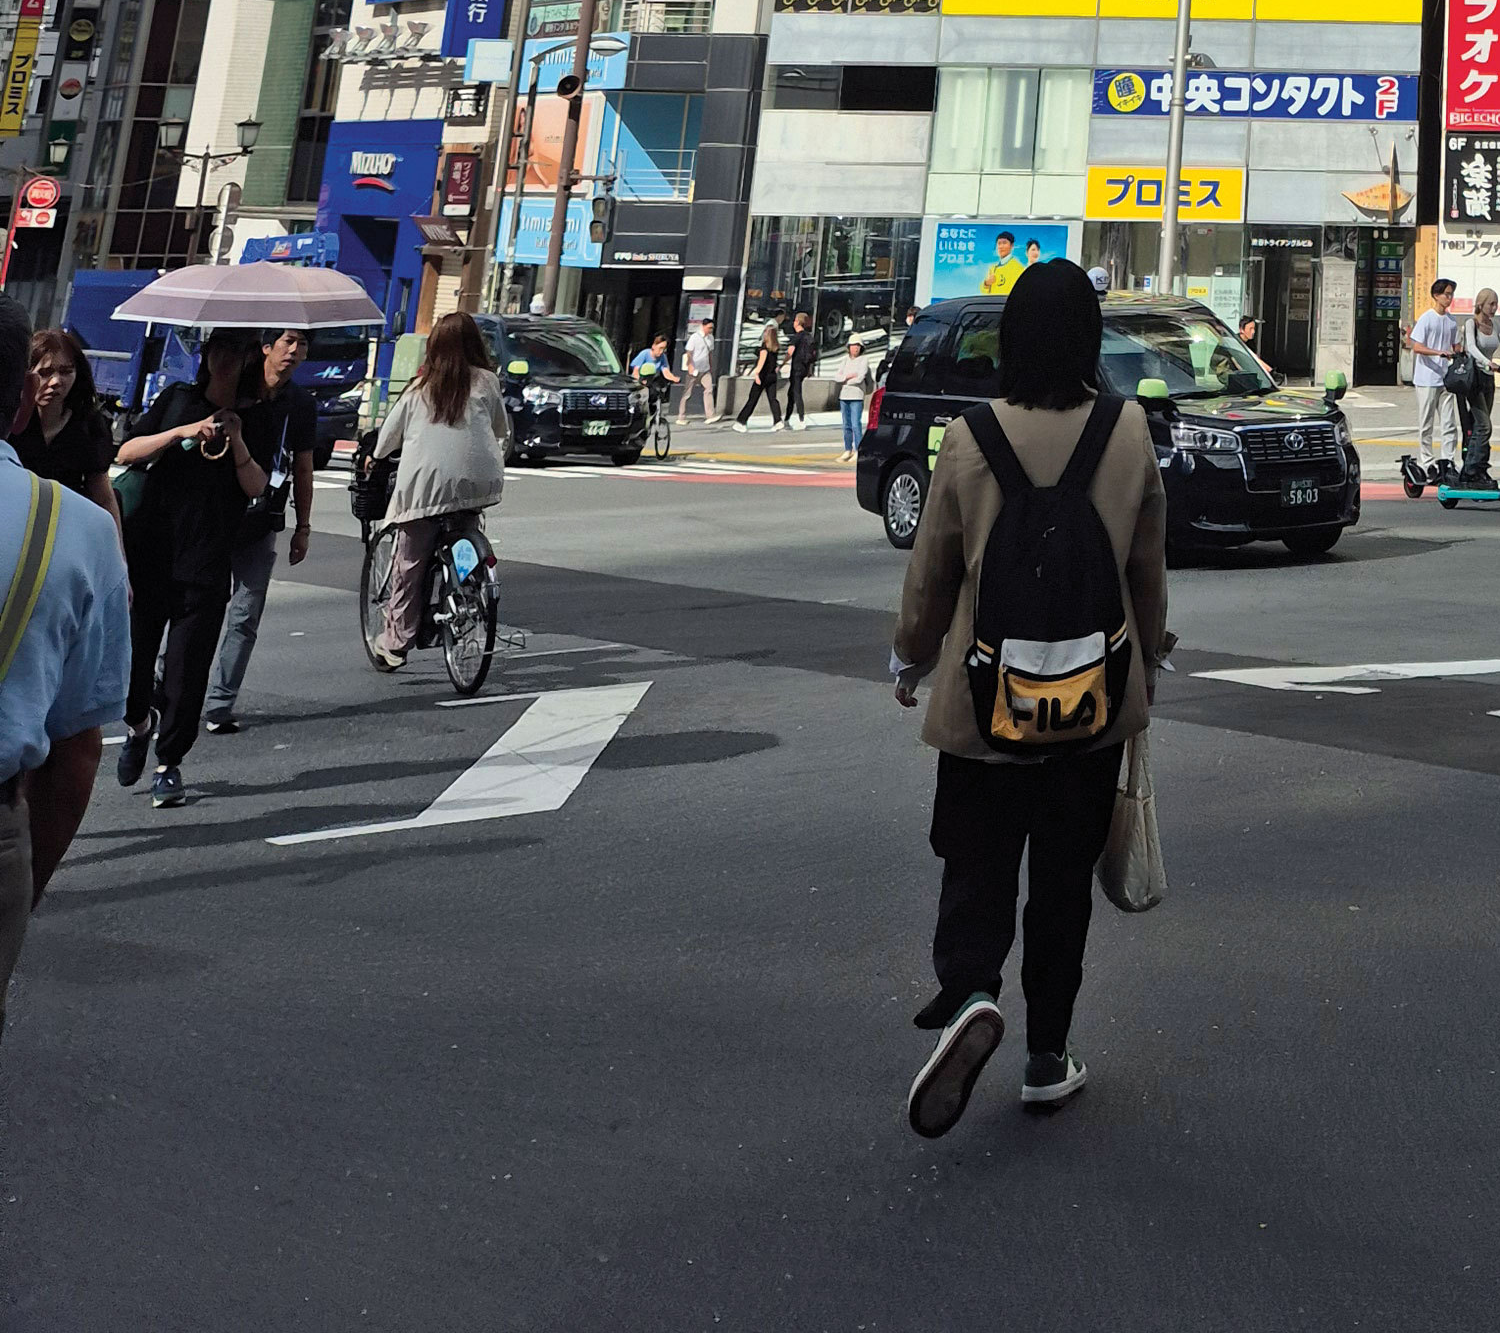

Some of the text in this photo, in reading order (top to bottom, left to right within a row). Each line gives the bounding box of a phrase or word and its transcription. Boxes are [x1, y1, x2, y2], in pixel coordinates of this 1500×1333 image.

[3, 53, 33, 116] プロミス
[1150, 73, 1365, 117] 中央コンタクト
[1448, 137, 1467, 151] 6F
[349, 150, 396, 176] MIZUHO
[1105, 174, 1223, 209] プロミス
[1460, 153, 1493, 221] 楽蔵
[939, 227, 977, 240] あなたに
[938, 253, 975, 264] プロミス
[1008, 690, 1097, 733] FILA
